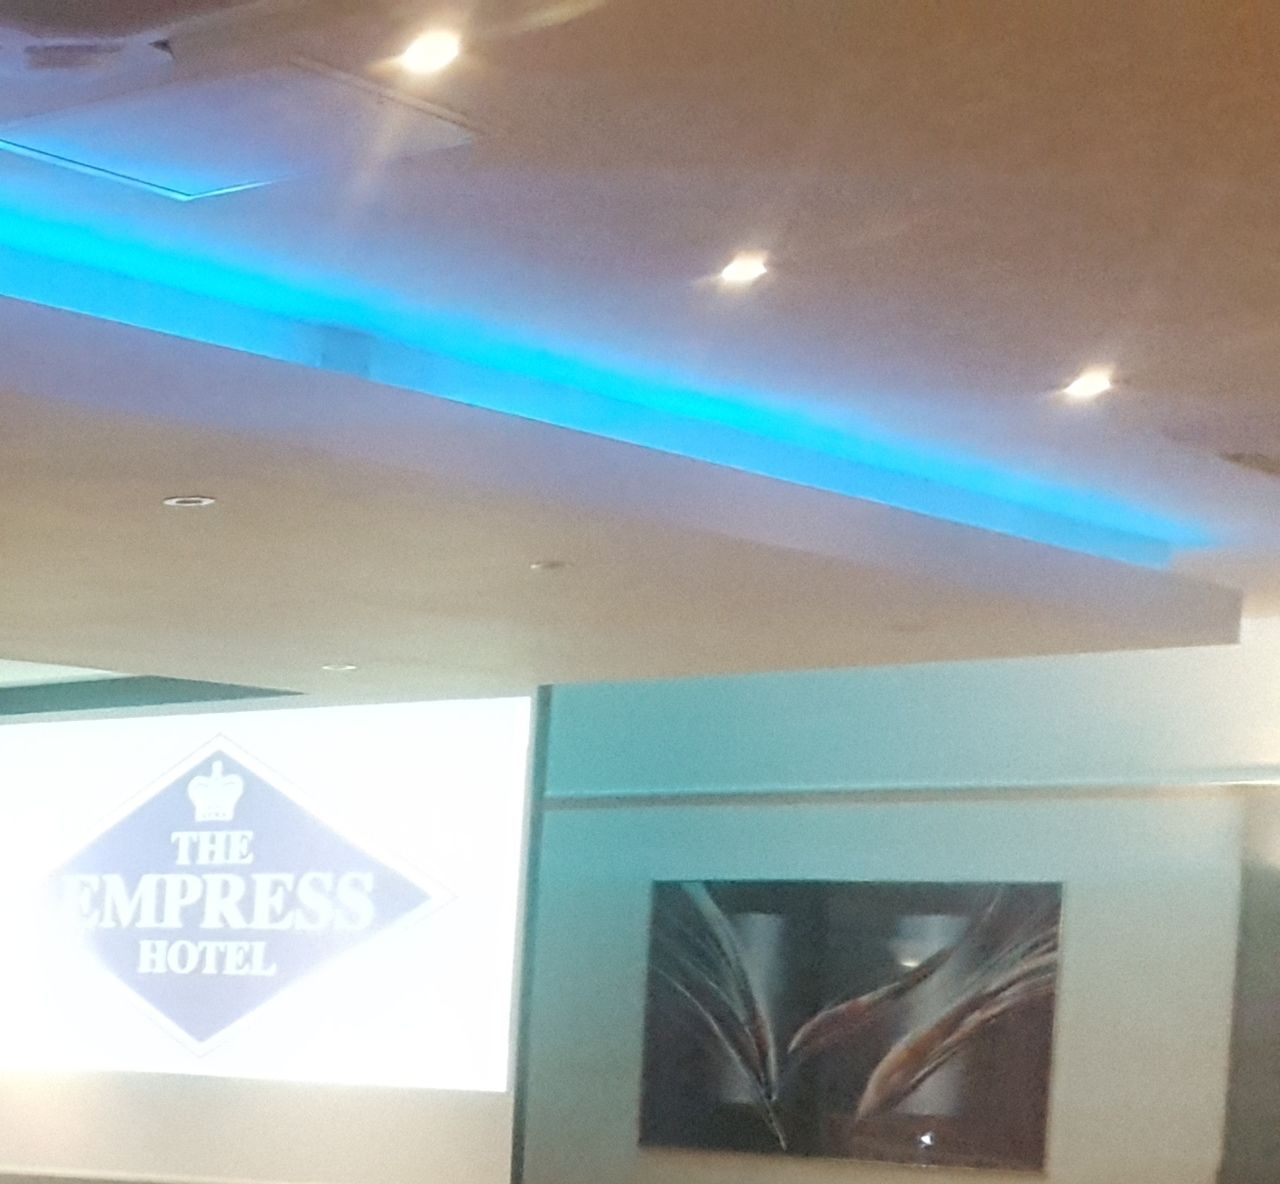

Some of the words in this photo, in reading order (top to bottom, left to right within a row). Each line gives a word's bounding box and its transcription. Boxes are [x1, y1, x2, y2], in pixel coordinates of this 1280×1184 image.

[170, 830, 254, 865] THE
[61, 871, 375, 930] EMPRESS
[137, 939, 277, 976] HOTEL
